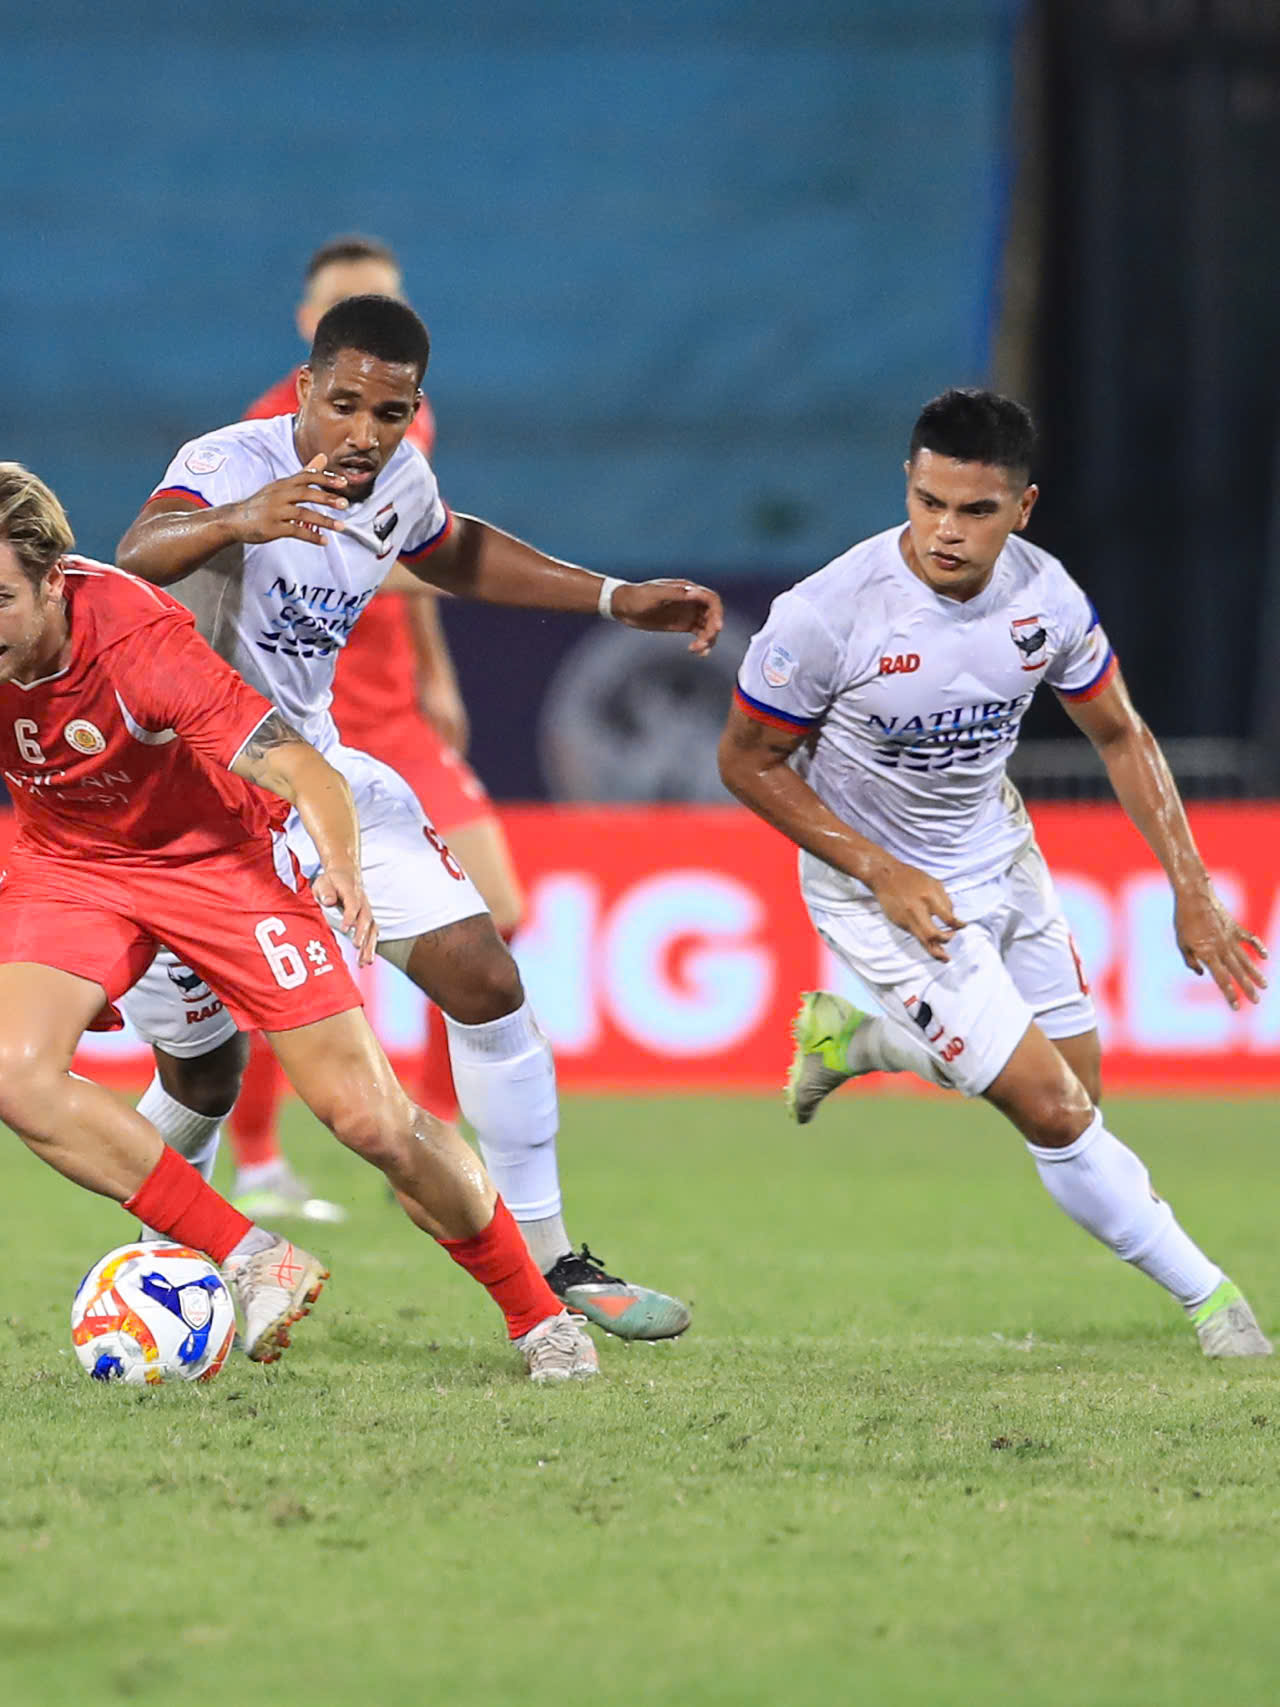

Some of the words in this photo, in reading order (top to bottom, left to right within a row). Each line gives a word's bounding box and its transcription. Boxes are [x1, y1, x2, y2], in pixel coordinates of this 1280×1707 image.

[880, 653, 920, 675] RAD
[14, 718, 46, 764] 6
[255, 916, 307, 990] 6
